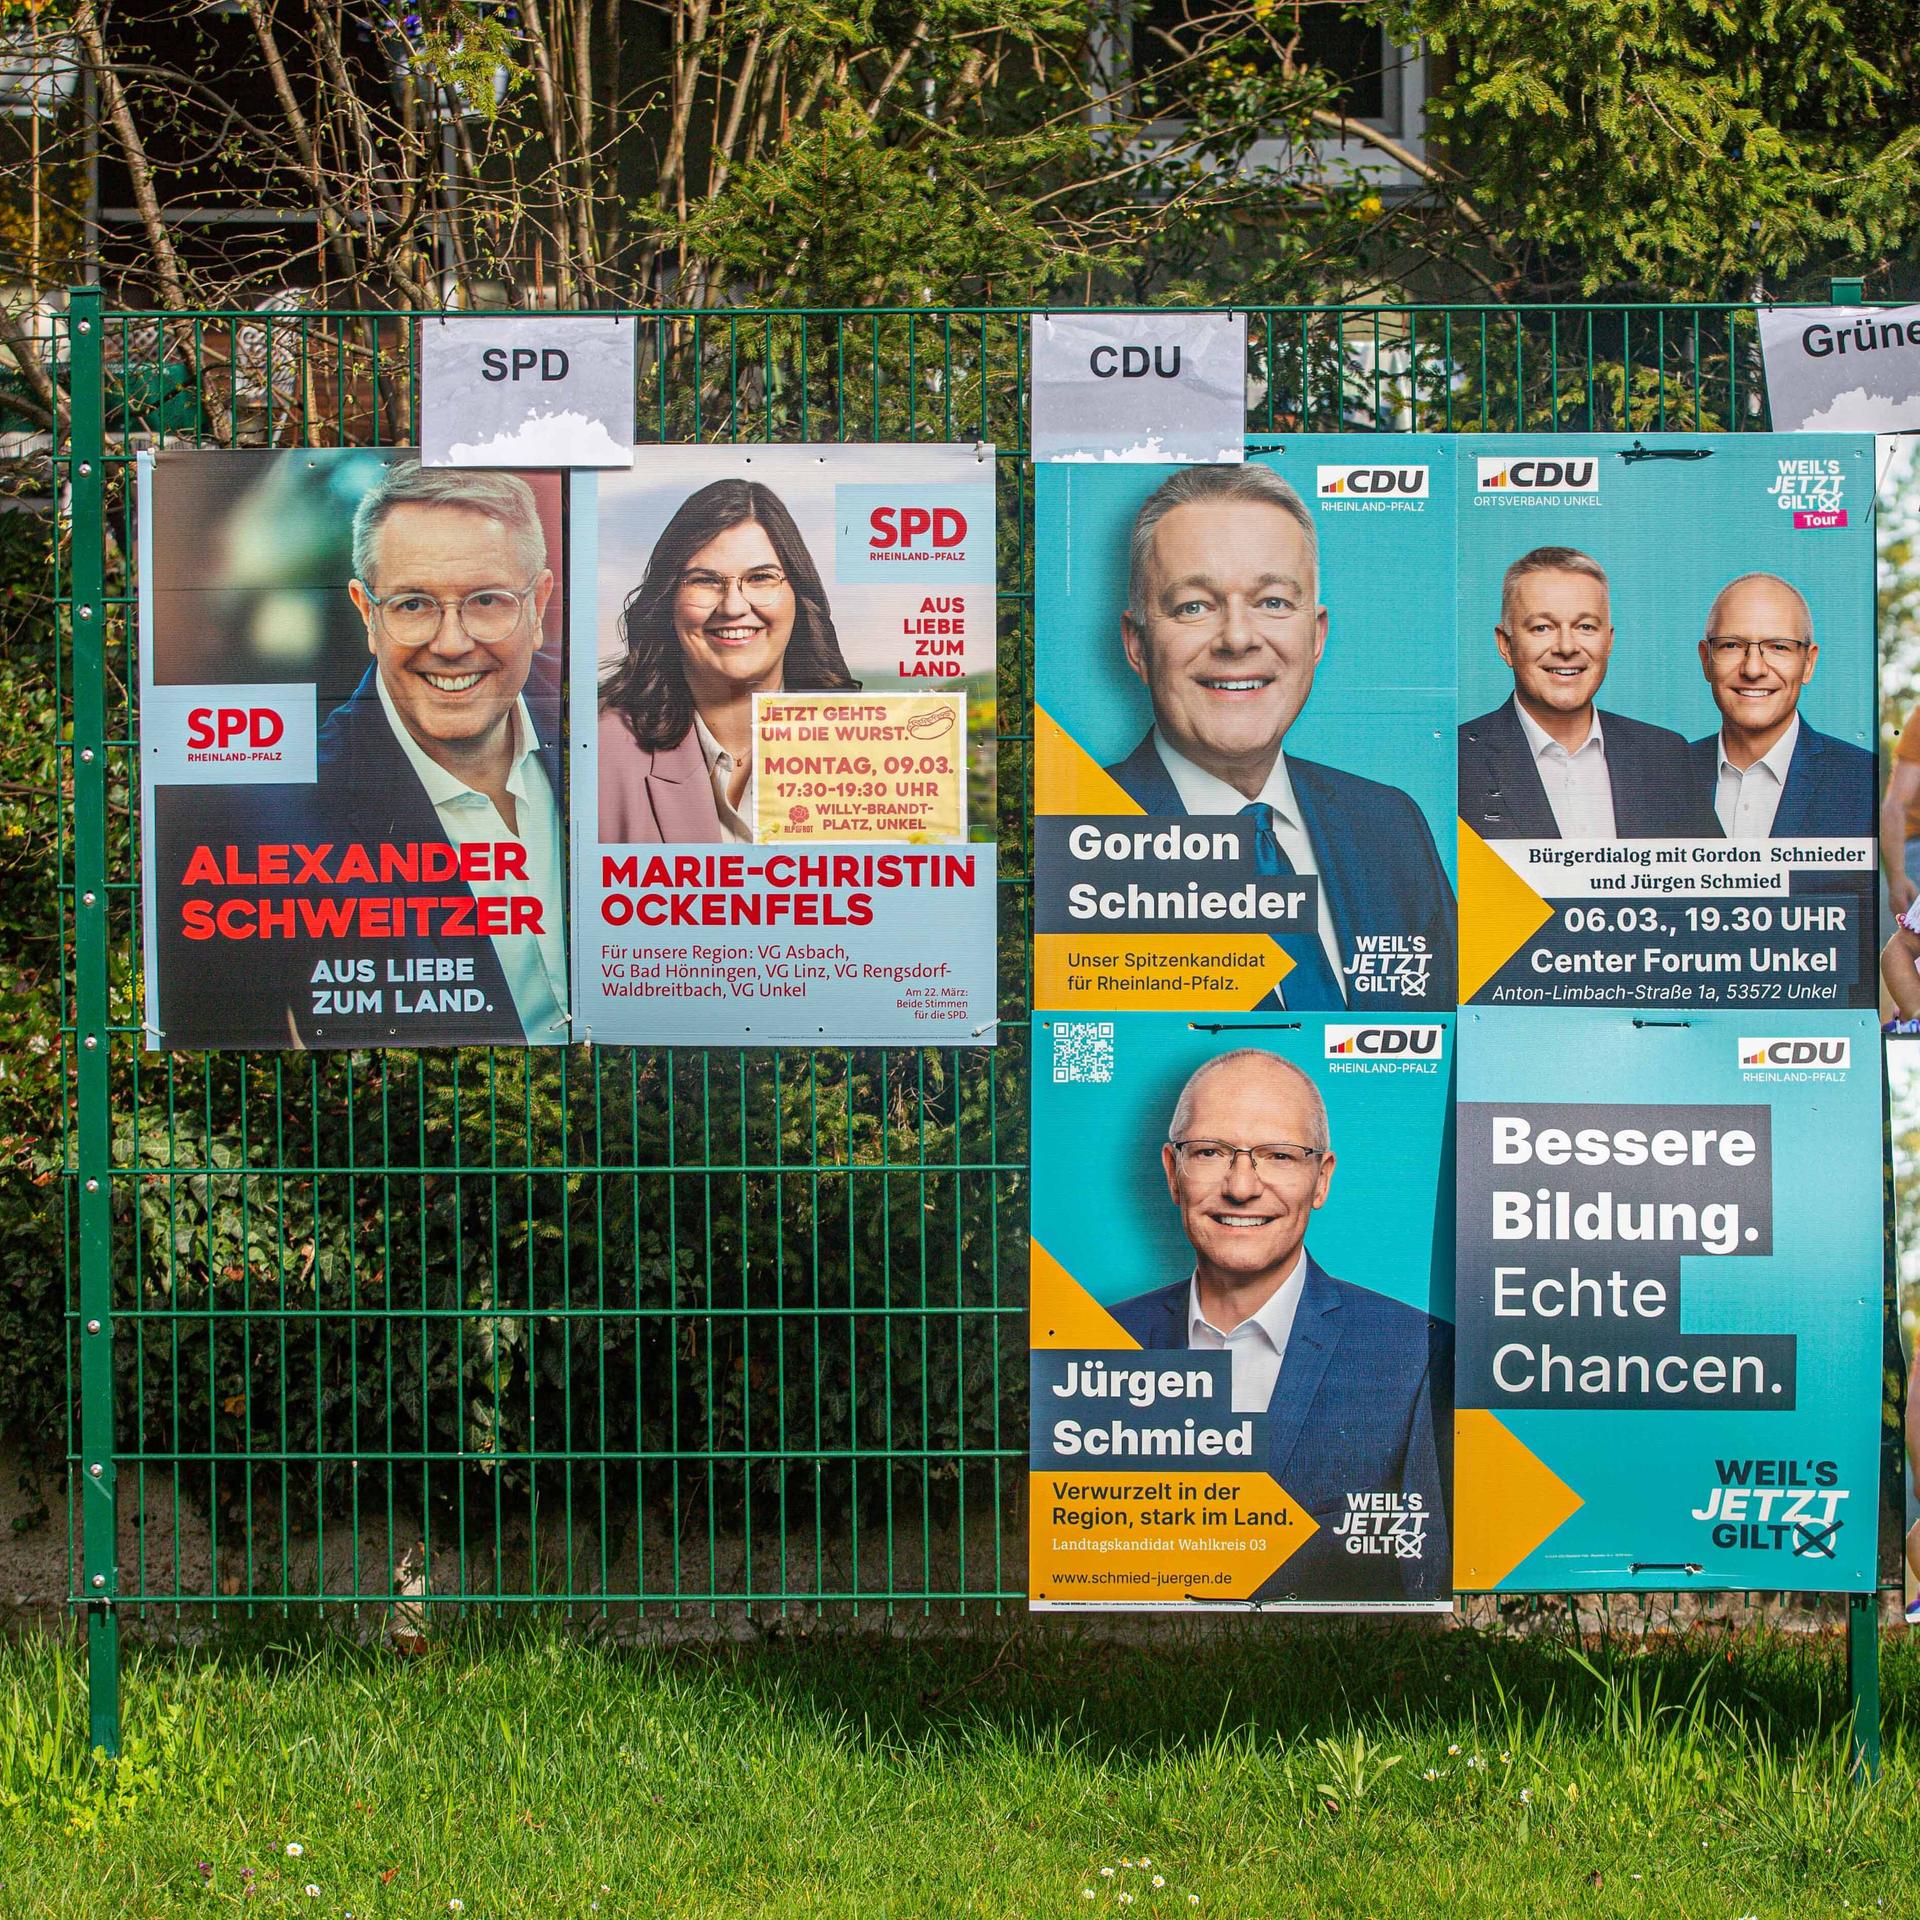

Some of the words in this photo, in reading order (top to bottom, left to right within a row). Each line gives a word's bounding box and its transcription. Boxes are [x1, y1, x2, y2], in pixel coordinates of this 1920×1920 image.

[482, 348, 569, 381] SPD
[1090, 346, 1180, 378] CDU
[1347, 470, 1424, 494] CDU
[1510, 462, 1593, 487] CDU
[1767, 475, 1845, 494] JETZT
[1321, 501, 1424, 512] RHEINLAND-PFALZ
[1474, 496, 1561, 506] ORTSVERBAND
[1564, 496, 1602, 506] UNKEL
[1778, 494, 1816, 509] GILT
[869, 507, 967, 548] SPD
[1804, 513, 1837, 527] Tour
[870, 552, 966, 561] RHEINLAND-PFALZ
[920, 598, 965, 613] AUS
[903, 619, 964, 634] LIEBE
[915, 640, 964, 656] ZUM
[899, 661, 966, 677] LAND.
[761, 706, 818, 722] JETZT
[823, 706, 887, 721] GEHTS
[187, 707, 284, 749] SPD
[762, 727, 792, 742] UM
[799, 727, 829, 741] DIE
[835, 725, 909, 741] WURST.
[188, 752, 282, 762] RHEINLAND-PFALZ
[765, 756, 877, 776] MONTAG,
[883, 756, 954, 774] 09.03.
[777, 782, 887, 797] 17:30-19:30
[896, 782, 939, 797] UHR
[816, 804, 934, 815] WILLY-BRANDT-
[823, 819, 873, 831] PLATZ,
[876, 818, 926, 830] UNKEL
[1069, 824, 1239, 861] Gordon
[182, 842, 529, 886] ALEXANDER
[1529, 847, 1651, 865] Bürgerdialog
[1656, 848, 1686, 863] mit
[1692, 848, 1761, 863] Gordon
[1771, 846, 1866, 862] Schnieder
[602, 855, 975, 887] MARIE-CHRISTIN
[1590, 874, 1625, 890] und
[1630, 874, 1695, 893] Jürgen
[1701, 872, 1781, 890] Schmied
[601, 893, 873, 926] OCKENFELS
[1068, 881, 1306, 920] Schnieder
[182, 896, 545, 940] SCHWEITZER
[1564, 907, 1676, 936] 06.03.,
[1685, 906, 1772, 931] 19.30
[1781, 906, 1846, 931] UHR
[602, 945, 627, 960] Für
[633, 948, 688, 960] unsere
[693, 946, 753, 964] Region:
[758, 946, 780, 960] VG
[786, 946, 849, 962] Asbach,
[1068, 953, 1119, 968] Unser
[1124, 952, 1265, 971] Spitzenkandidat
[1344, 954, 1431, 974] JETZT
[1531, 948, 1636, 973] Center
[1644, 948, 1742, 972] Forum
[1750, 947, 1837, 972] Unkel
[311, 959, 375, 983] AUS
[387, 958, 474, 982] LIEBE
[602, 965, 625, 978] VG
[630, 964, 660, 978] Bad
[666, 964, 761, 982] Hönningen,
[765, 965, 789, 978] VG
[794, 964, 830, 981] Linz,
[834, 965, 857, 978] VG
[863, 964, 952, 982] Rengsdorf-
[602, 983, 727, 1000] Waldbreitbach,
[731, 984, 754, 997] VG
[760, 983, 806, 997] Unkel
[905, 988, 921, 997] Am
[924, 988, 938, 997] 22.
[941, 987, 968, 997] März:
[1068, 976, 1091, 991] für
[1097, 975, 1239, 991] Rheinland-Pfalz.
[1355, 976, 1400, 992] GILT
[313, 991, 382, 1014] ZUM
[394, 990, 494, 1014] LAND.
[1492, 984, 1692, 1002] Anton-Limbach-Straße
[1698, 985, 1720, 1002] 1a,
[1727, 984, 1782, 1000] 53572
[1788, 984, 1837, 999] Unkel
[897, 999, 922, 1008] Beide
[925, 999, 968, 1008] Stimmen
[914, 1010, 928, 1019] für
[931, 1010, 944, 1019] die
[1356, 1029, 1436, 1054] CDU
[1769, 1041, 1845, 1064] CDU
[1329, 1063, 1437, 1074] RHEINLAND-PFALZ
[1743, 1072, 1846, 1082] RHEINLAND-PFALZ
[1492, 1116, 1756, 1166] Bessere
[1492, 1188, 1759, 1255] Bildung.
[1494, 1267, 1667, 1318] Echte
[1493, 1343, 1782, 1393] Chancen.
[1052, 1360, 1213, 1406] Jürgen
[1052, 1419, 1252, 1456] Schmied
[1052, 1482, 1172, 1501] Verwurzelt
[1179, 1482, 1196, 1500] in
[1204, 1482, 1240, 1500] der
[1691, 1488, 1849, 1522] JETZT
[1052, 1508, 1134, 1529] Region,
[1141, 1507, 1195, 1526] stark
[1203, 1507, 1227, 1525] im
[1234, 1507, 1293, 1526] Land.
[1334, 1512, 1429, 1535] JETZT
[1052, 1538, 1175, 1553] Landtagskandidat
[1179, 1538, 1246, 1551] Wahlkreis
[1250, 1539, 1266, 1551] 03
[1346, 1536, 1394, 1554] GILT
[1712, 1525, 1791, 1550] GILT
[1052, 1572, 1232, 1587] www.schmied-juergen.de
